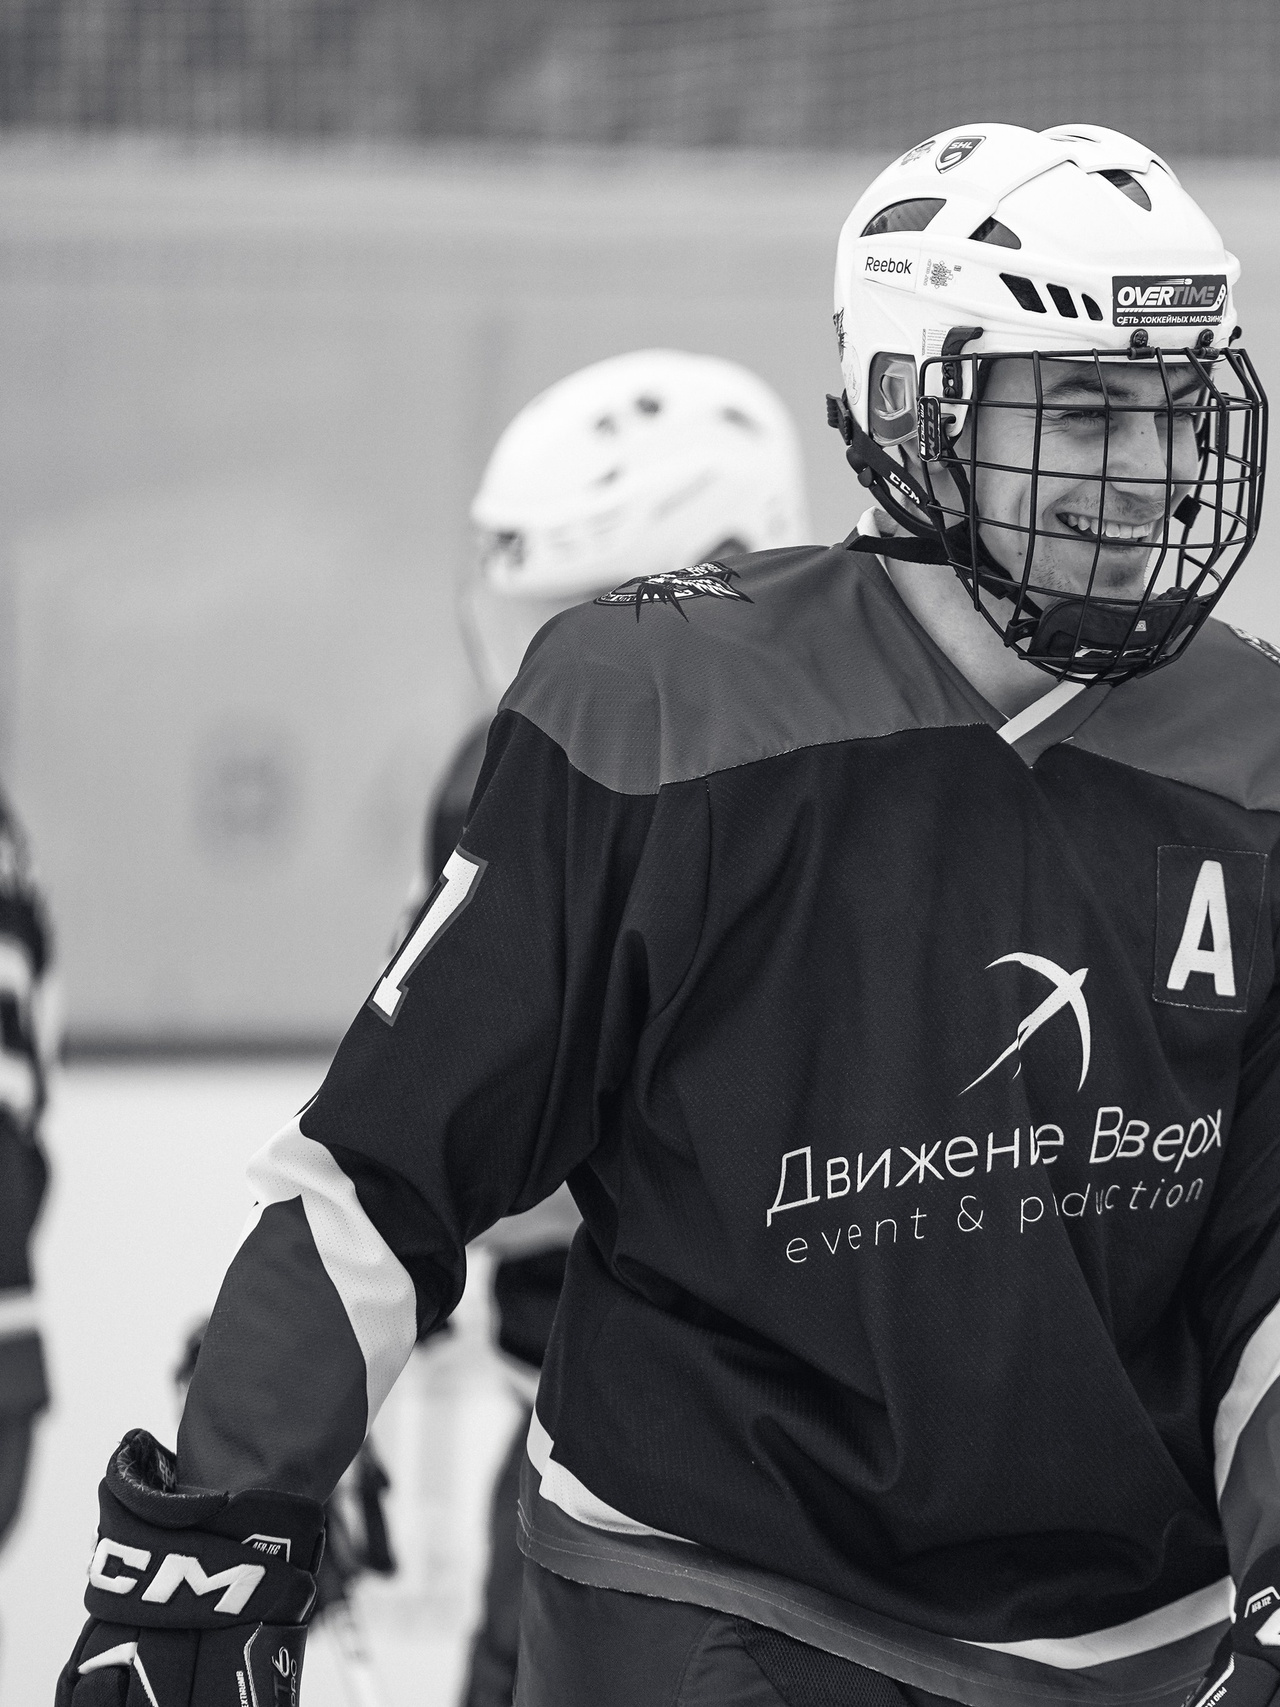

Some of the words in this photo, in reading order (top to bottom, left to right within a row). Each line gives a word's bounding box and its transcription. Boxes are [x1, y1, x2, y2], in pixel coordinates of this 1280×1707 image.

[864, 256, 913, 275] Reebok
[1117, 285, 1216, 307] OVERTIME
[1116, 315, 1139, 325] СЕТЬ
[1140, 314, 1189, 325] ХОККЕЙНЫХ
[927, 402, 936, 457] CCM
[889, 471, 920, 505] CCM
[1166, 859, 1237, 997] A
[1089, 1106, 1222, 1173] Вверх
[785, 1208, 928, 1263] event
[957, 1195, 985, 1233] &
